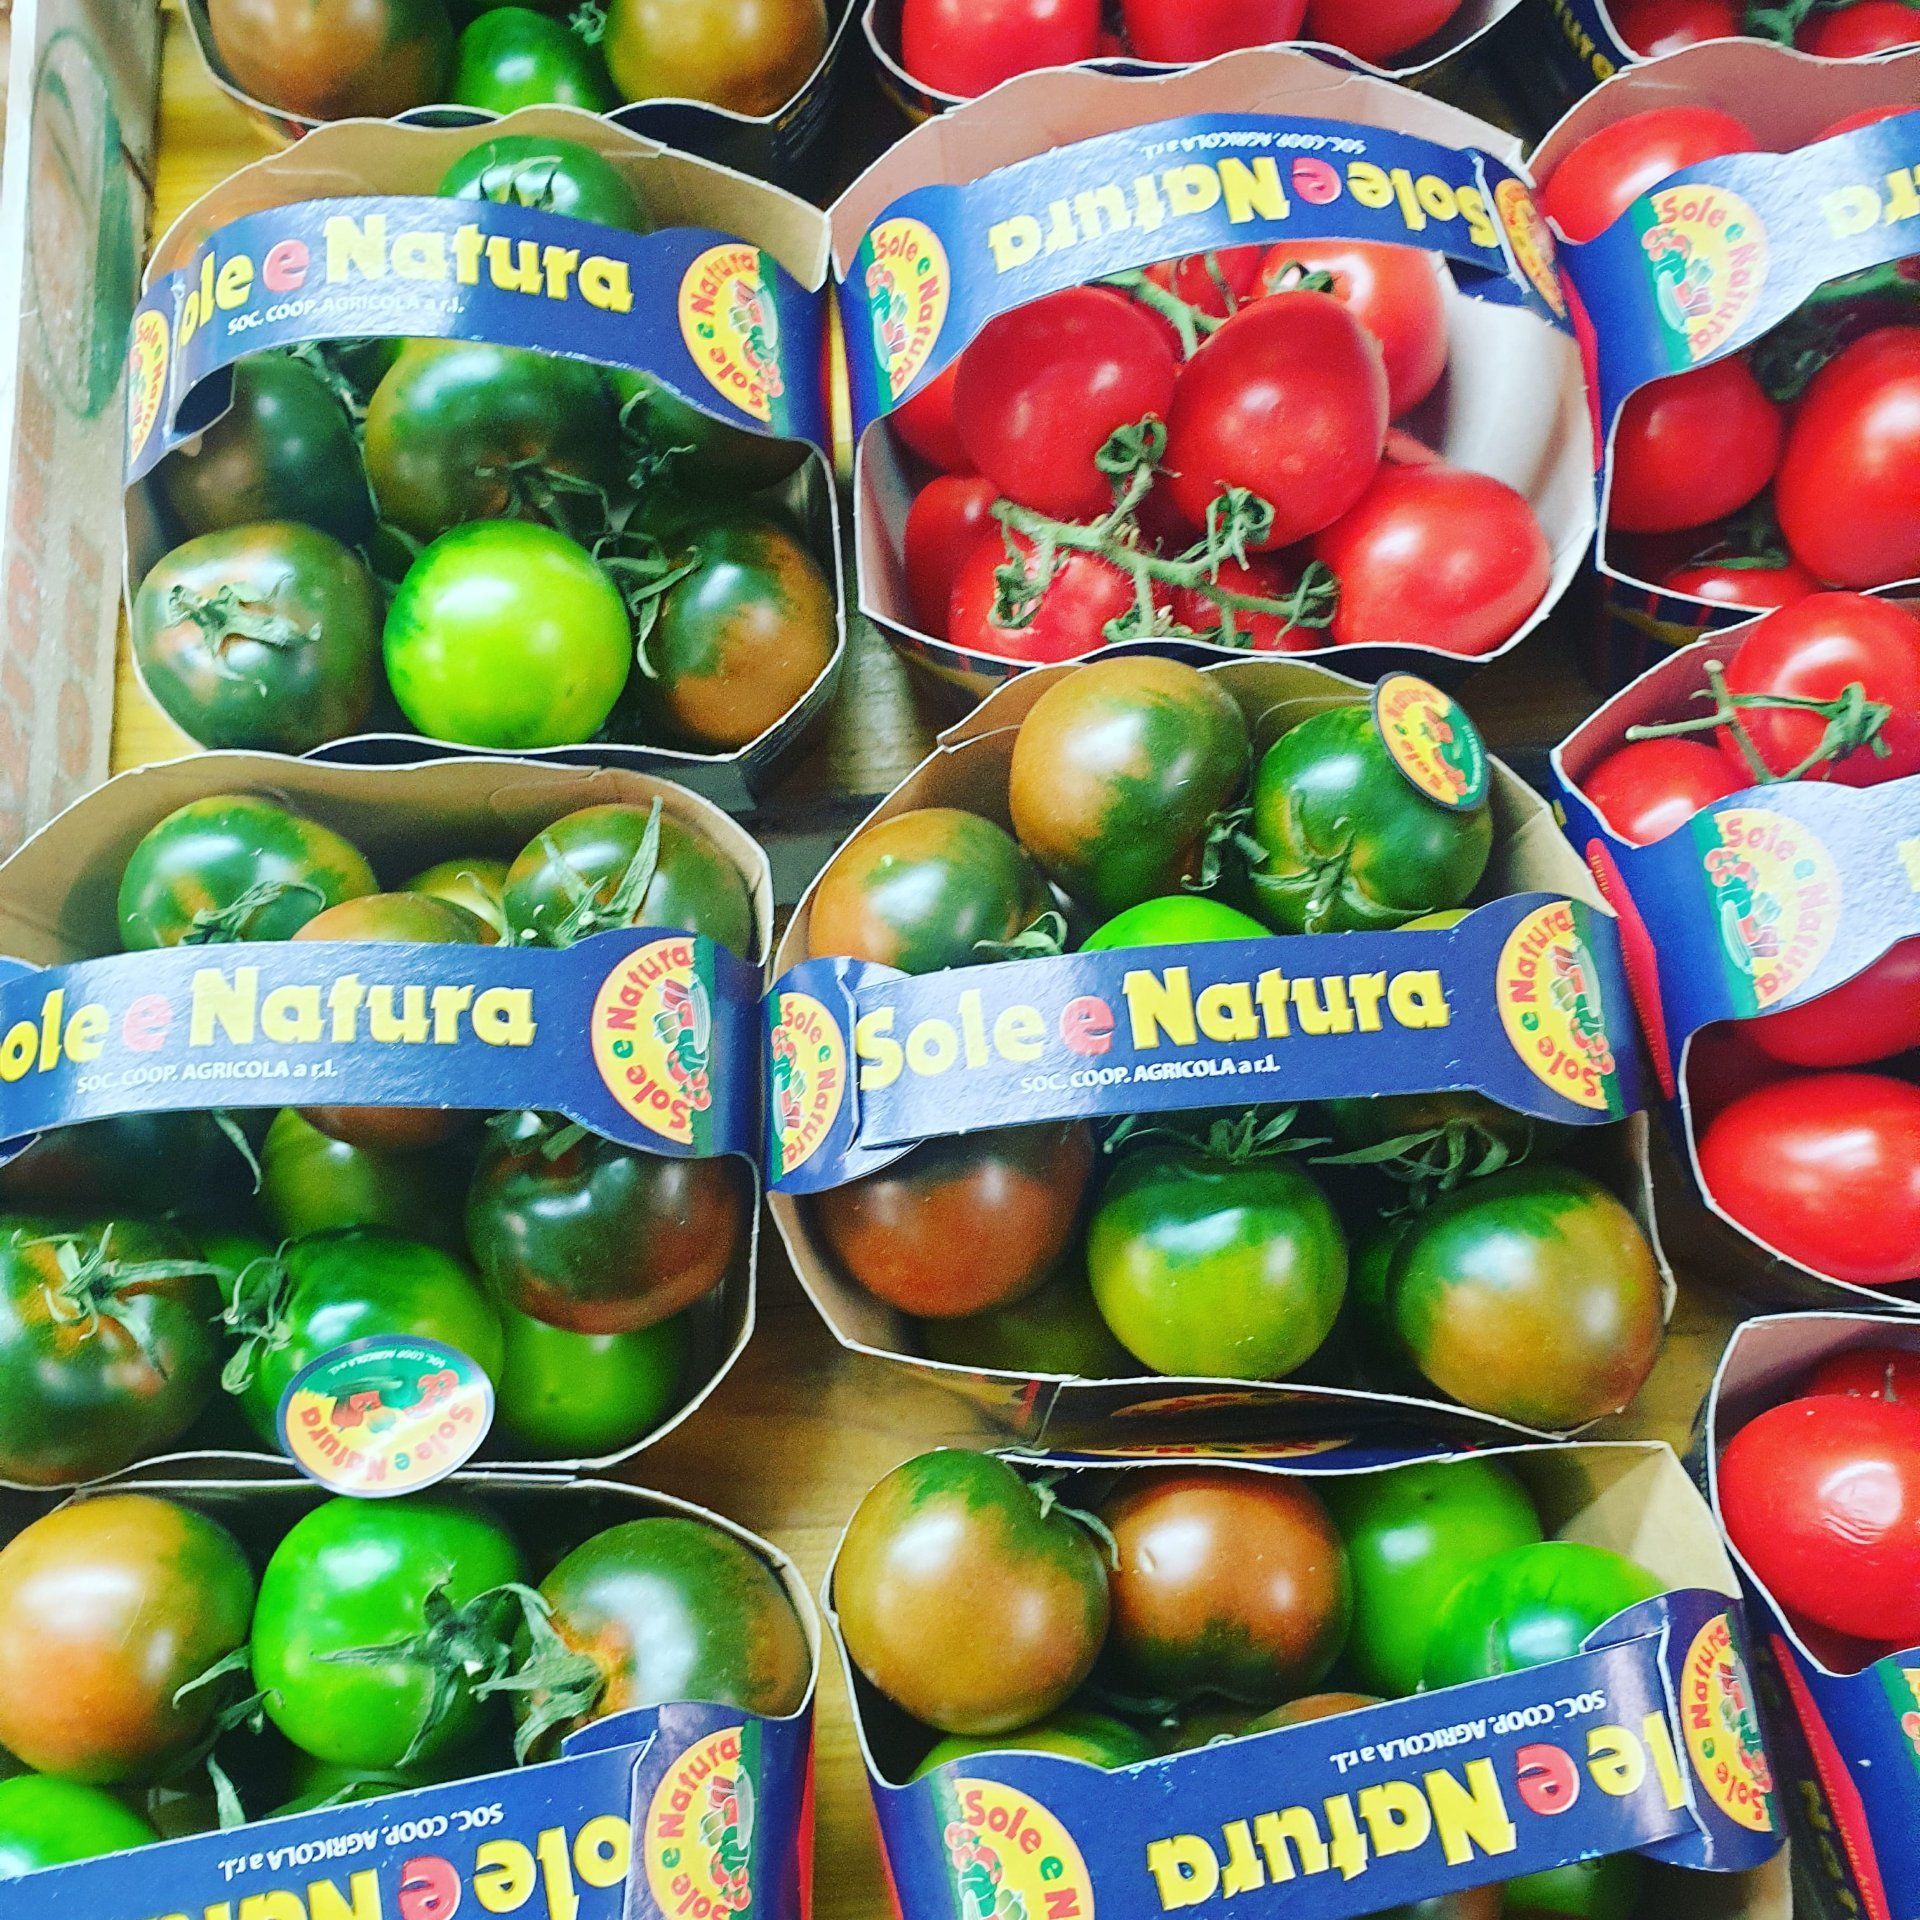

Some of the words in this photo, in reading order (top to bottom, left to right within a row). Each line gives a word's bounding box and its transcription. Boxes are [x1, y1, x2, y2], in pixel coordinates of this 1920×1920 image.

[1291, 157, 1341, 204] e
[1348, 161, 1500, 249] Sole
[988, 157, 1291, 275] Natura
[1660, 195, 1727, 228] Sole
[1724, 222, 1745, 243] e
[877, 229, 918, 262] Sole
[917, 256, 931, 277] e
[177, 251, 254, 347] ole
[262, 239, 309, 292] e
[323, 214, 634, 314] Natura
[691, 251, 759, 316] Natura
[1690, 242, 1758, 350] Natura
[696, 322, 714, 339] e
[891, 275, 941, 388] Natura
[708, 347, 767, 408] Sole
[1725, 817, 1797, 862] Sole
[1508, 909, 1574, 1004] Natura
[606, 945, 692, 1031] Natura
[0, 988, 111, 1083] ole
[122, 993, 174, 1053] e
[189, 966, 539, 1048] Natura
[611, 1039, 635, 1059] e
[782, 1001, 822, 1045] Sole
[855, 988, 1047, 1093] Sole
[1059, 995, 1116, 1057] e
[1122, 965, 1451, 1050] Natura
[1521, 1011, 1540, 1032] e
[182, 1059, 290, 1081] AGRICOLA
[818, 1044, 832, 1064] e
[1070, 1066, 1131, 1088] COOP.
[1133, 1058, 1238, 1084] AGRICOLA
[1537, 1036, 1597, 1098] Sole
[625, 1064, 690, 1129] Sole
[782, 1066, 837, 1164] Natura
[300, 1405, 390, 1482] Natura
[414, 1402, 475, 1458] Sole
[394, 1451, 411, 1471] e
[1488, 1703, 1556, 1737] COOP.
[1556, 1689, 1607, 1719] SOC.
[1376, 1720, 1488, 1763] AGRICOLA
[1586, 1710, 1688, 1811] le
[656, 1736, 741, 1839] Natura
[1515, 1742, 1581, 1816] e
[381, 1814, 449, 1847] COOP.
[450, 1802, 505, 1830] SOC.
[965, 1789, 1042, 1855] Sole
[1040, 1856, 1063, 1881] e
[1146, 1756, 1518, 1911] Natura
[267, 1833, 378, 1871] AGRICOLA
[473, 1816, 632, 1920] ole
[661, 1847, 681, 1869] e
[399, 1854, 462, 1920] e
